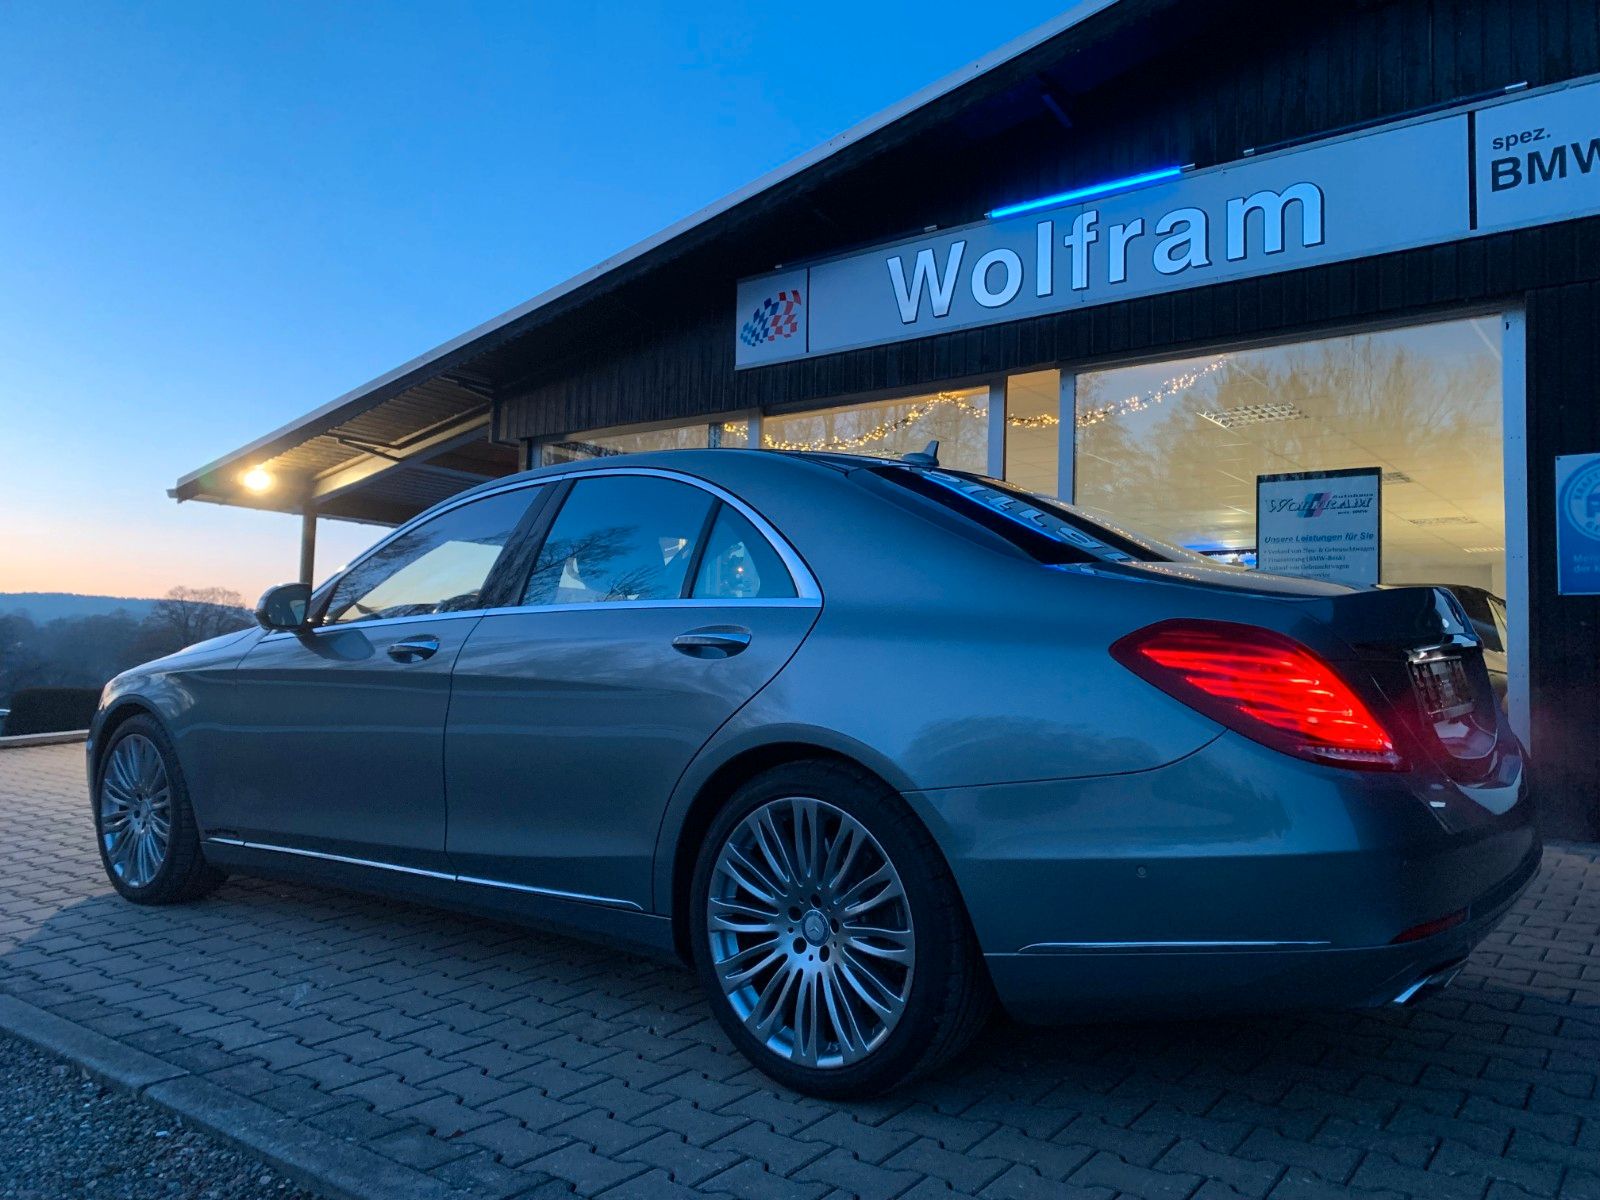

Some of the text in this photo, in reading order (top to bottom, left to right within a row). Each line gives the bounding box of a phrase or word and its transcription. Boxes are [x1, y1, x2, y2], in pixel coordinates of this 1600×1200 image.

[1492, 128, 1551, 151] spez.
[886, 181, 1325, 324] Wolfram
[1264, 531, 1374, 544] Unsere Leistungen für Sie
